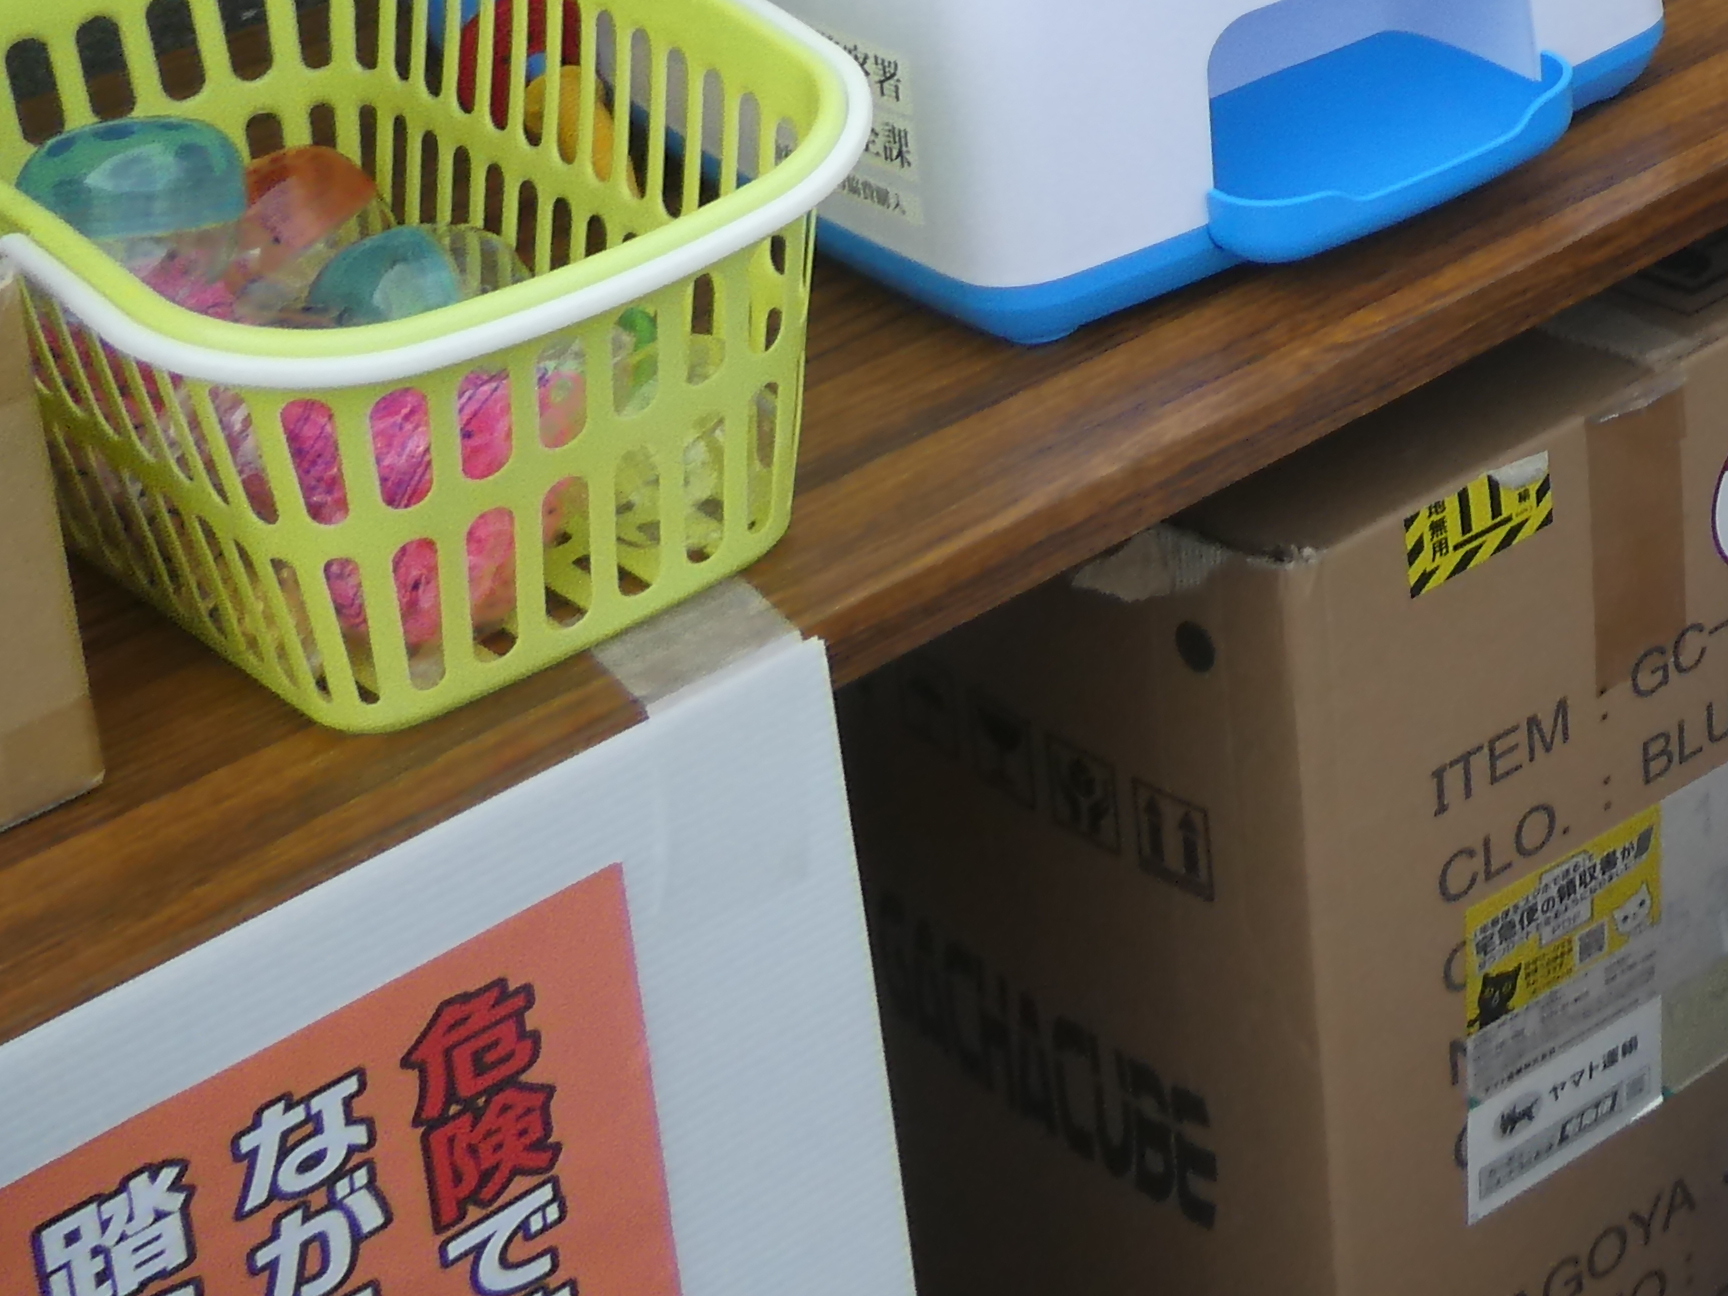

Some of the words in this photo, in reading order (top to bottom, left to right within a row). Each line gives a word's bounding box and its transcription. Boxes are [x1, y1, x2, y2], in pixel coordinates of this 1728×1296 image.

[1430, 695, 1570, 817] ITEM
[1438, 802, 1570, 903] CLO.
[1548, 1035, 1639, 1102] ヤマト運輸
[231, 1067, 394, 1296] なが
[401, 977, 580, 1296] 危険で
[31, 1158, 205, 1296] 踏
[1512, 1177, 1696, 1296] GOYA
